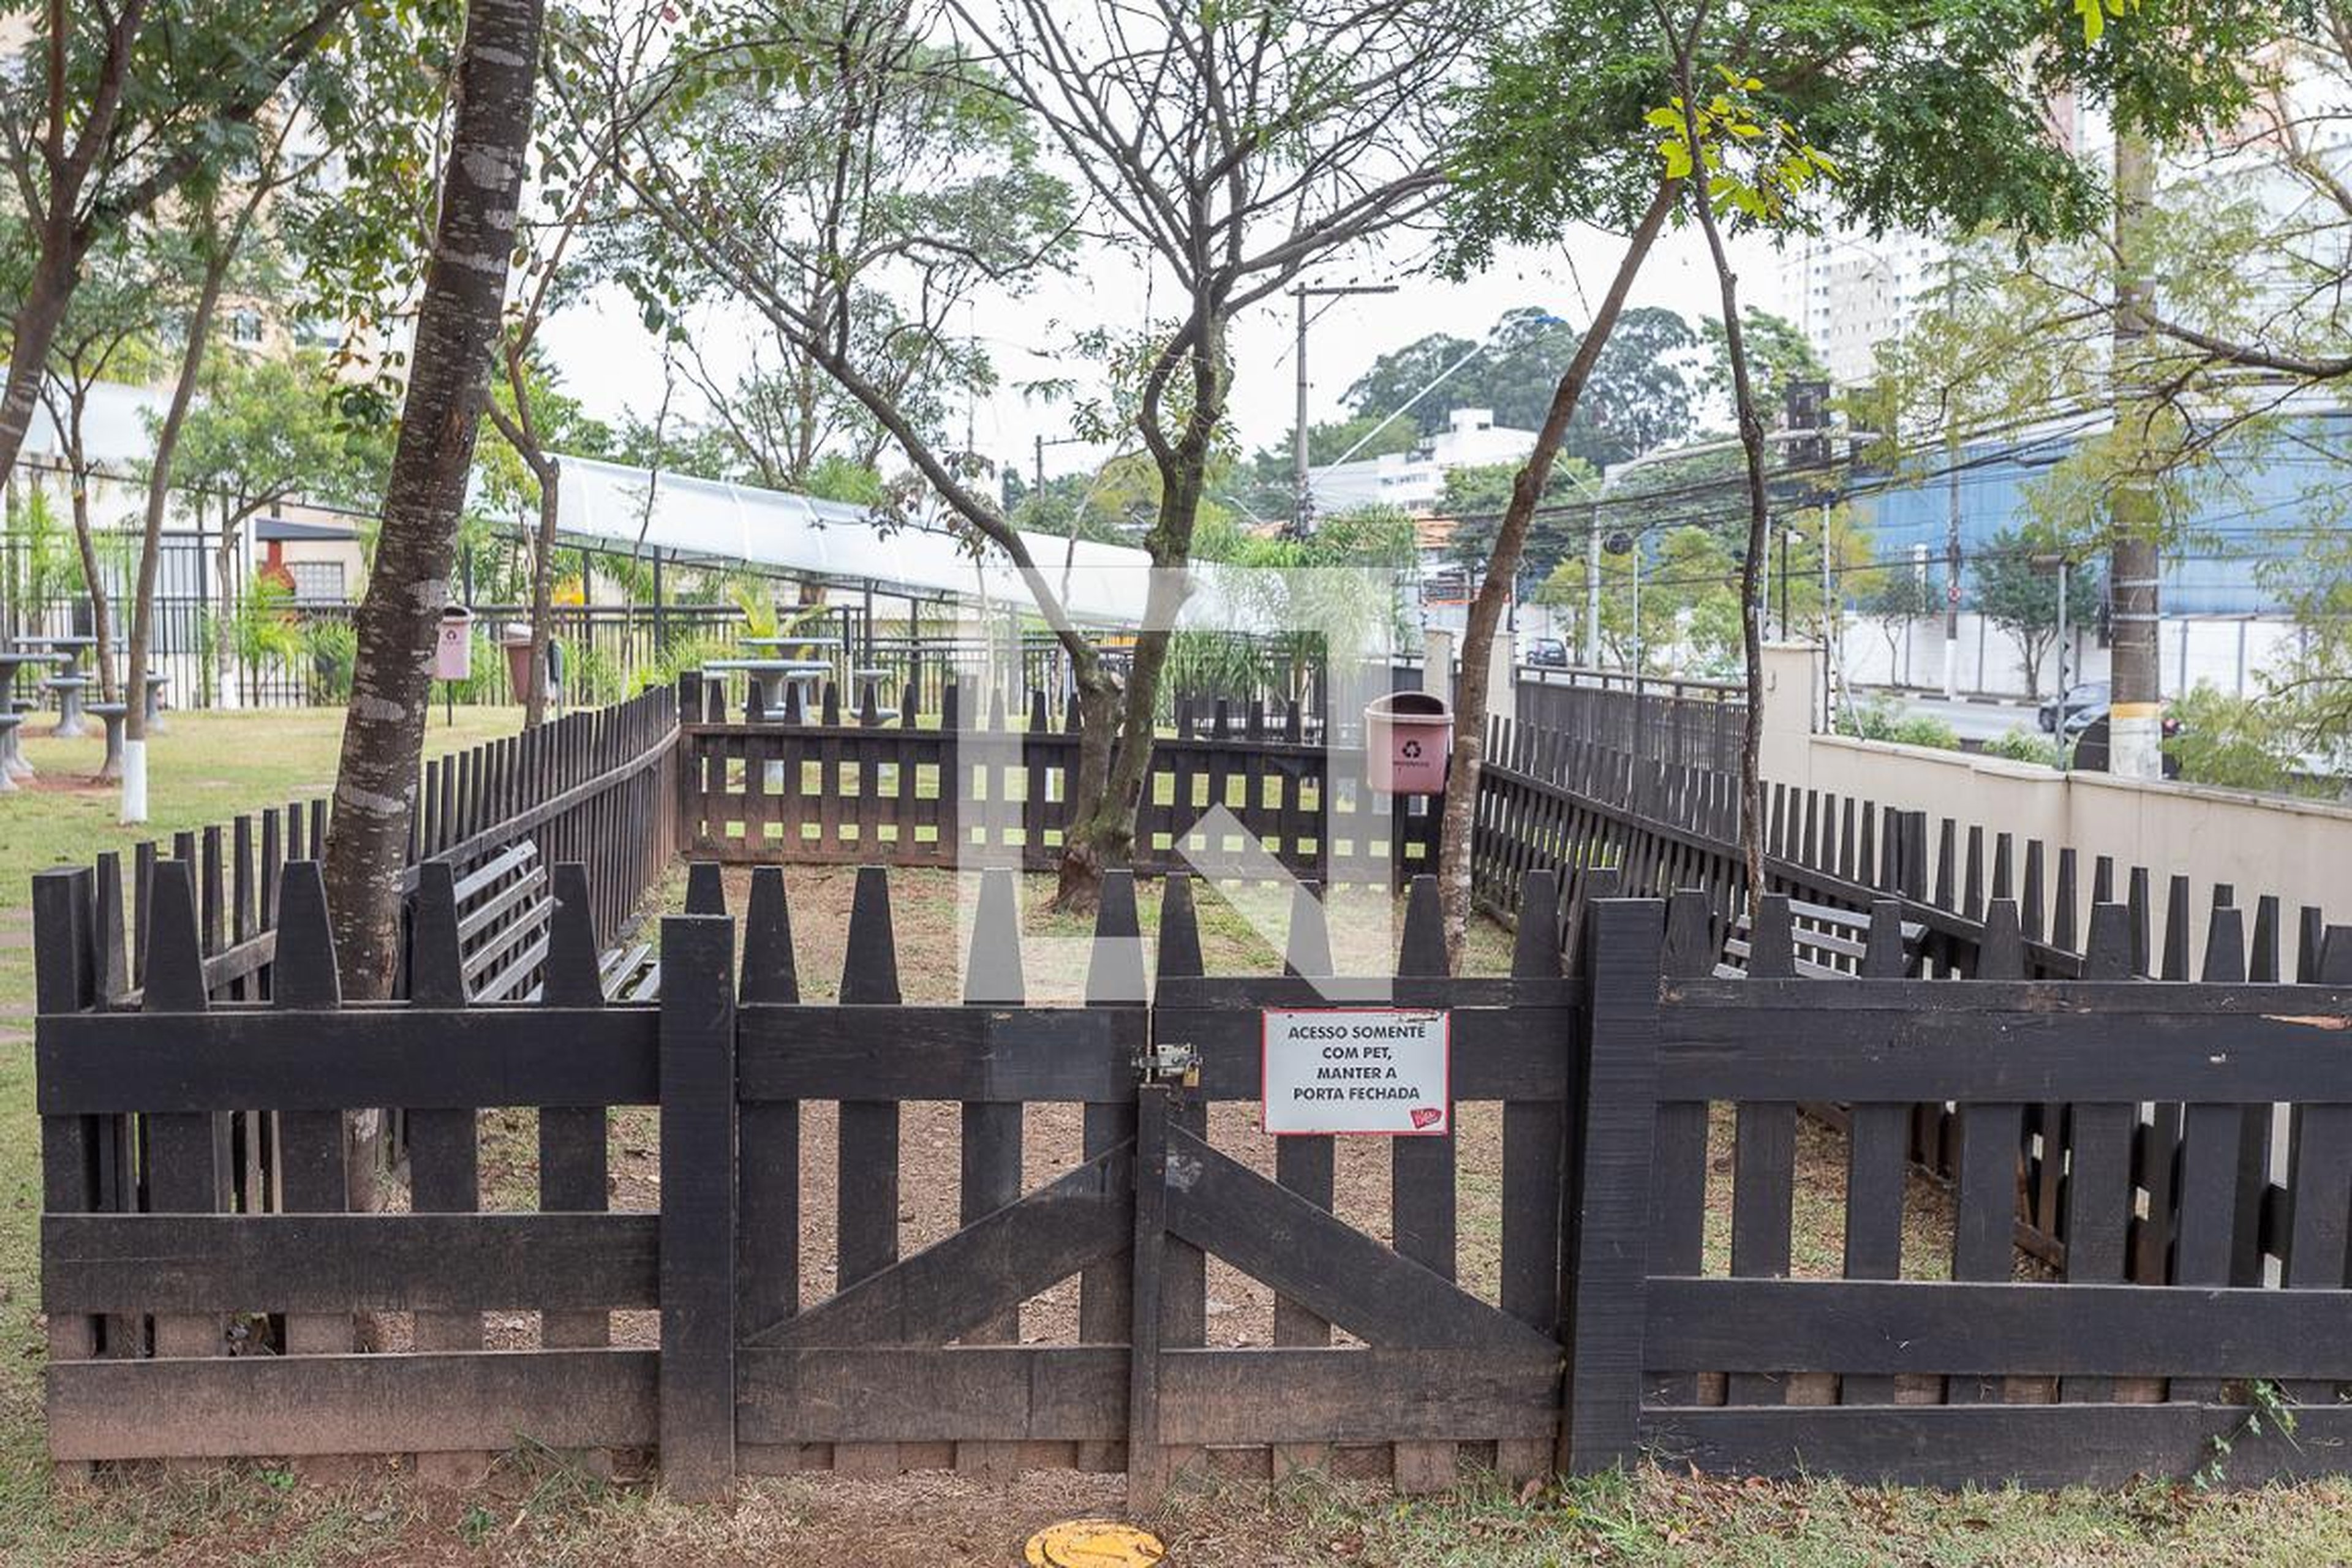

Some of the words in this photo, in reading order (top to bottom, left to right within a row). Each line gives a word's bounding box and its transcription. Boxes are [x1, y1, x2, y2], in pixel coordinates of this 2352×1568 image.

[1288, 1026, 1348, 1040] ACESSO
[1352, 1025, 1425, 1039] SOMENTE
[1322, 1047, 1359, 1060] COM
[1363, 1047, 1392, 1061] PET,
[1317, 1067, 1381, 1079] MANTER
[1385, 1067, 1397, 1079] A
[1294, 1087, 1344, 1101] PORTA
[1349, 1087, 1420, 1100] FECHADA
